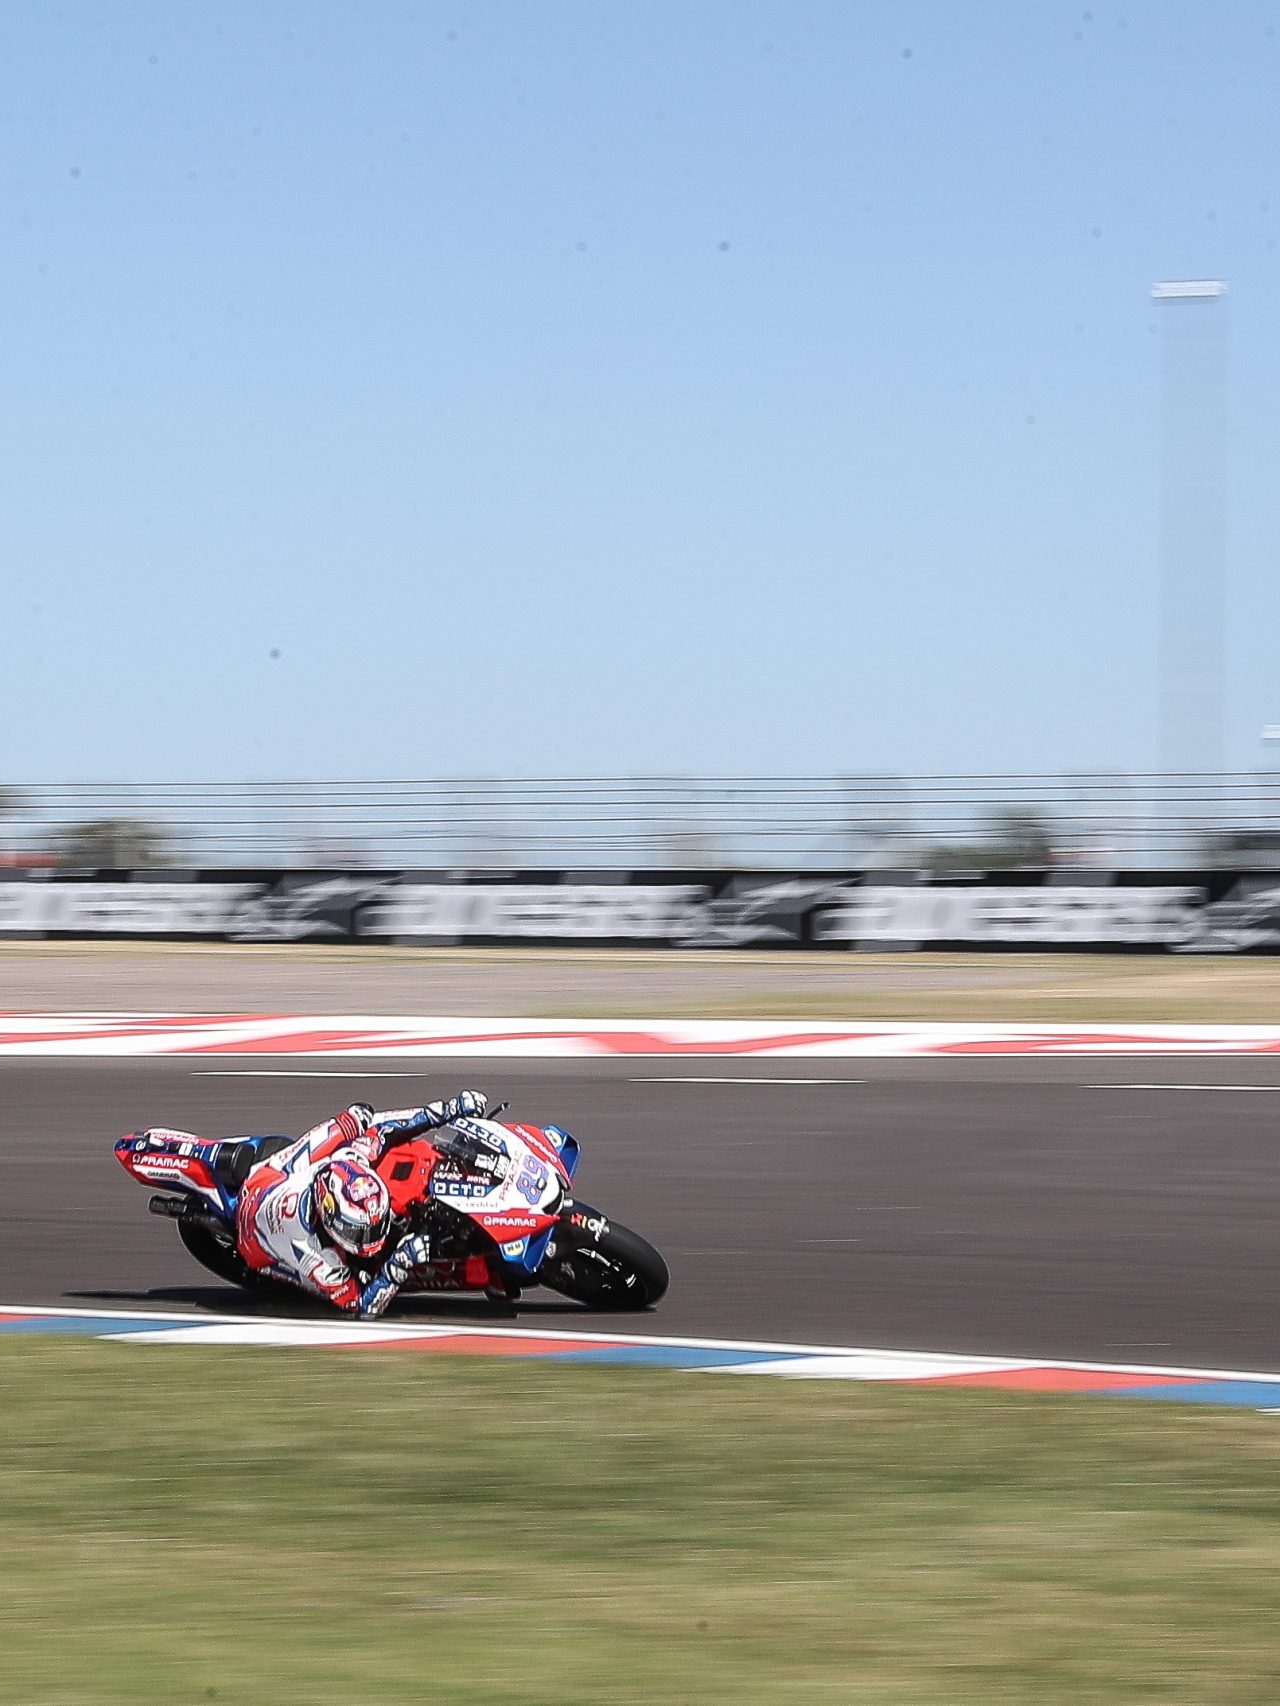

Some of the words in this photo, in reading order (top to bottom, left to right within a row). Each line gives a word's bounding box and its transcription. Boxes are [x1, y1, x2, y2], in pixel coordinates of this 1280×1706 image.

[140, 1156, 189, 1168] PRAMAC
[516, 1155, 549, 1205] 89
[434, 1181, 486, 1197] OCTO
[492, 1217, 537, 1227] PRAMAC
